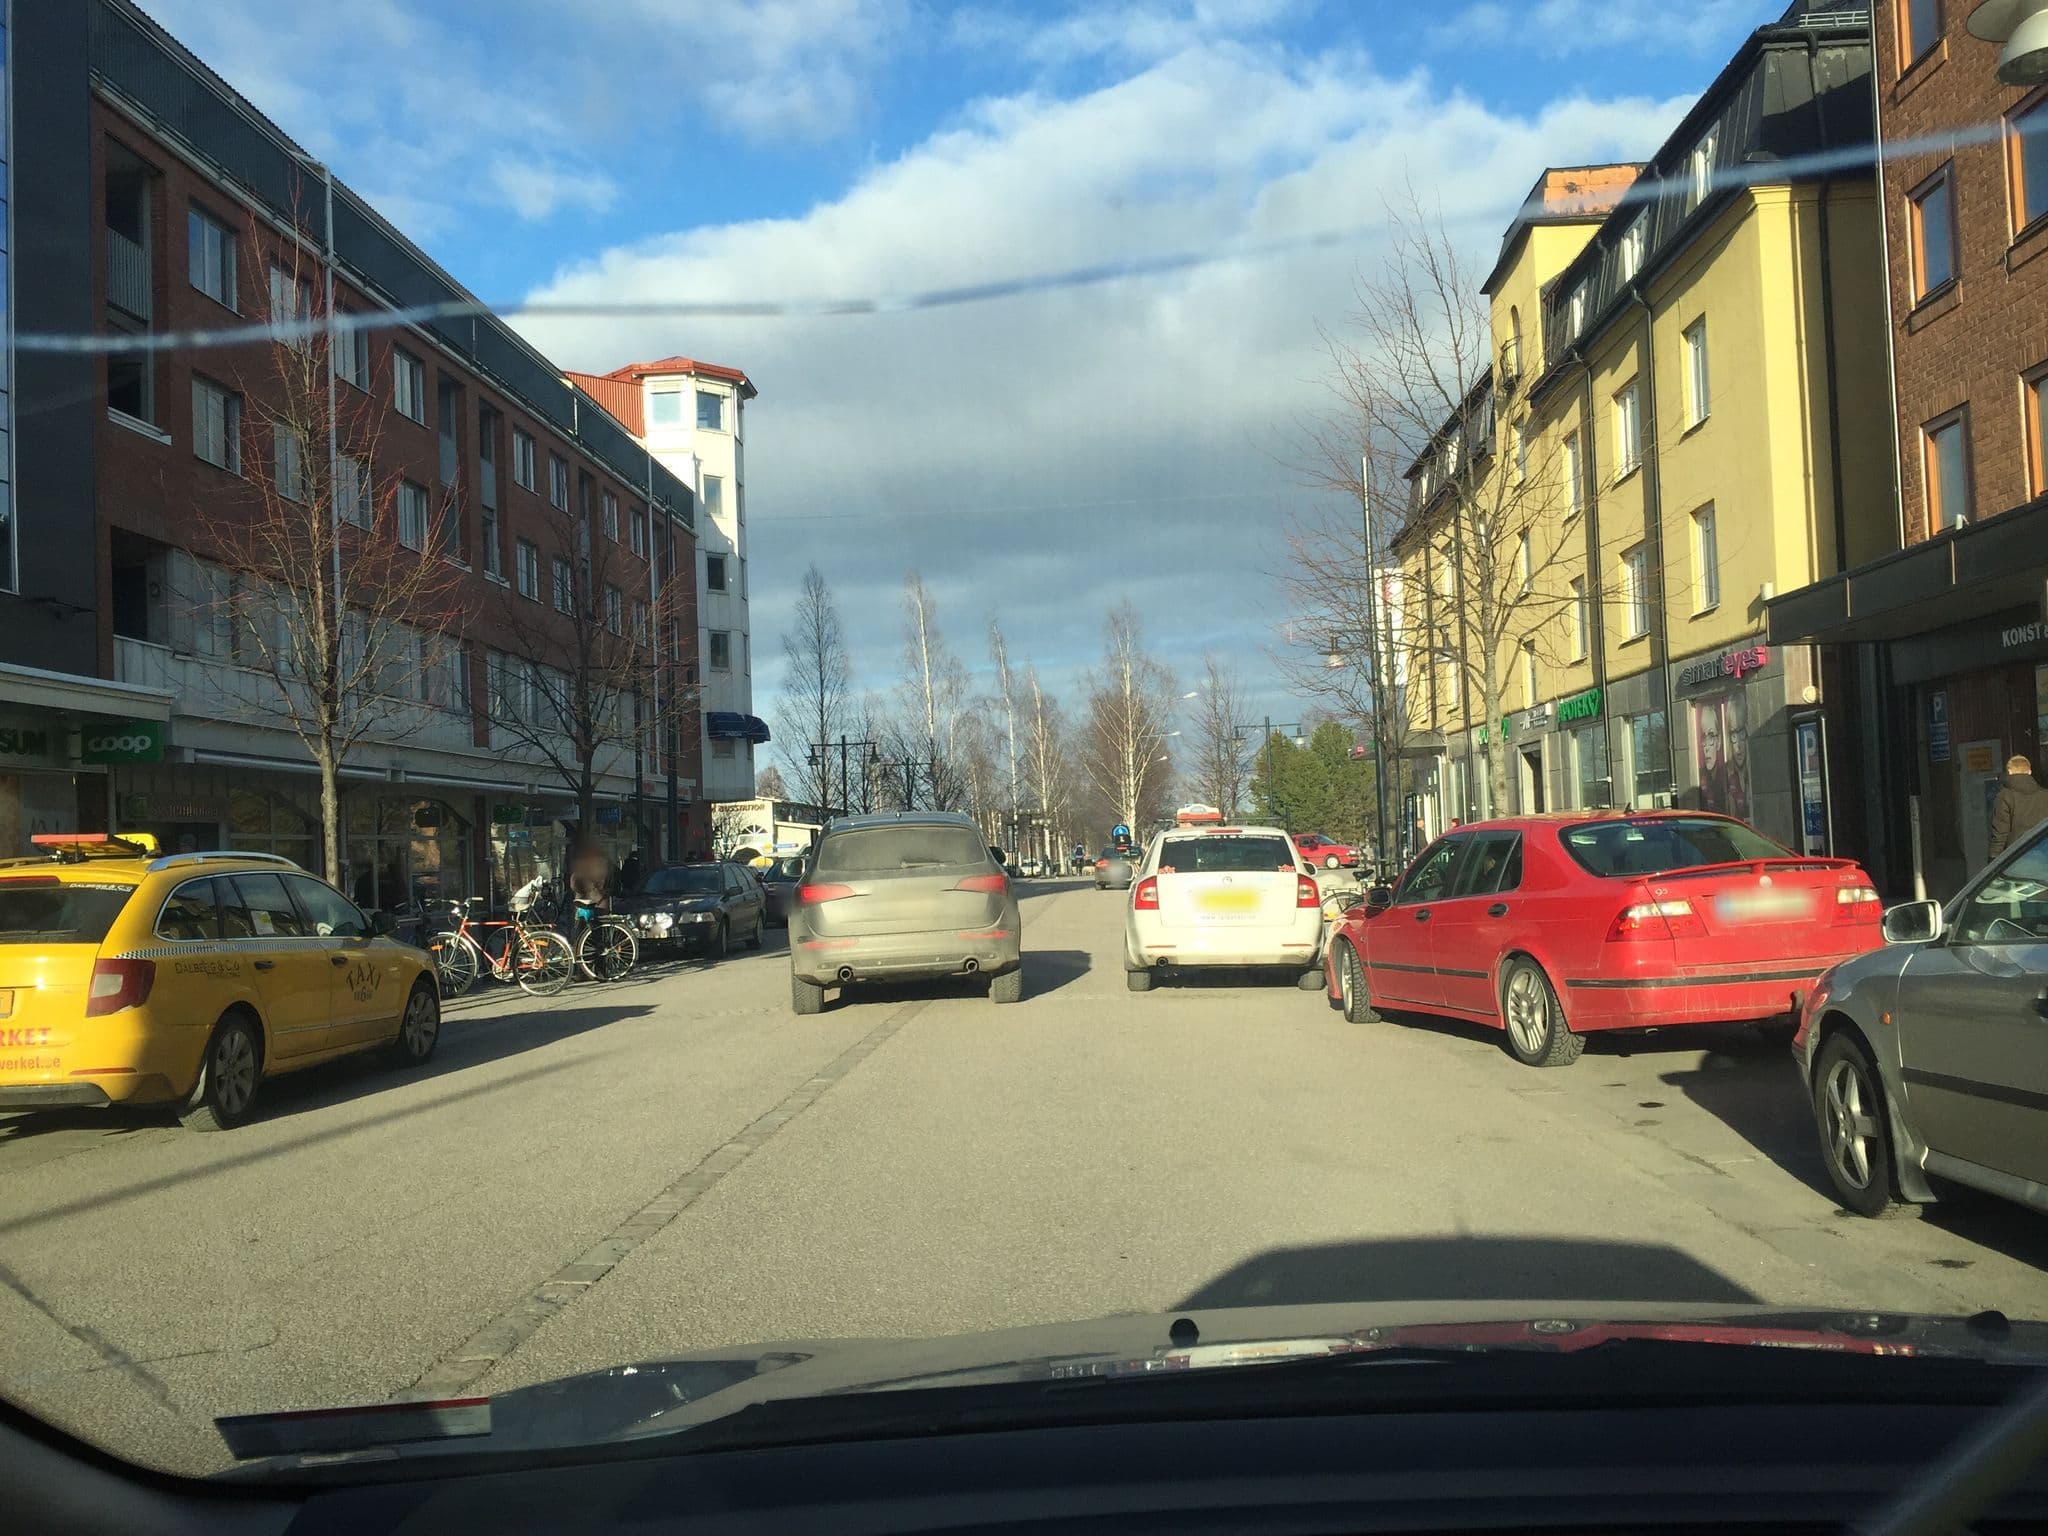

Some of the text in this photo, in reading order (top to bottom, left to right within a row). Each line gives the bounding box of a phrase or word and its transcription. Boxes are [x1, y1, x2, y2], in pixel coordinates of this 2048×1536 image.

[2002, 623, 2042, 648] KONST
[1682, 646, 1768, 686] smarteyes
[88, 735, 152, 754] coop
[345, 962, 381, 991] TAXI
